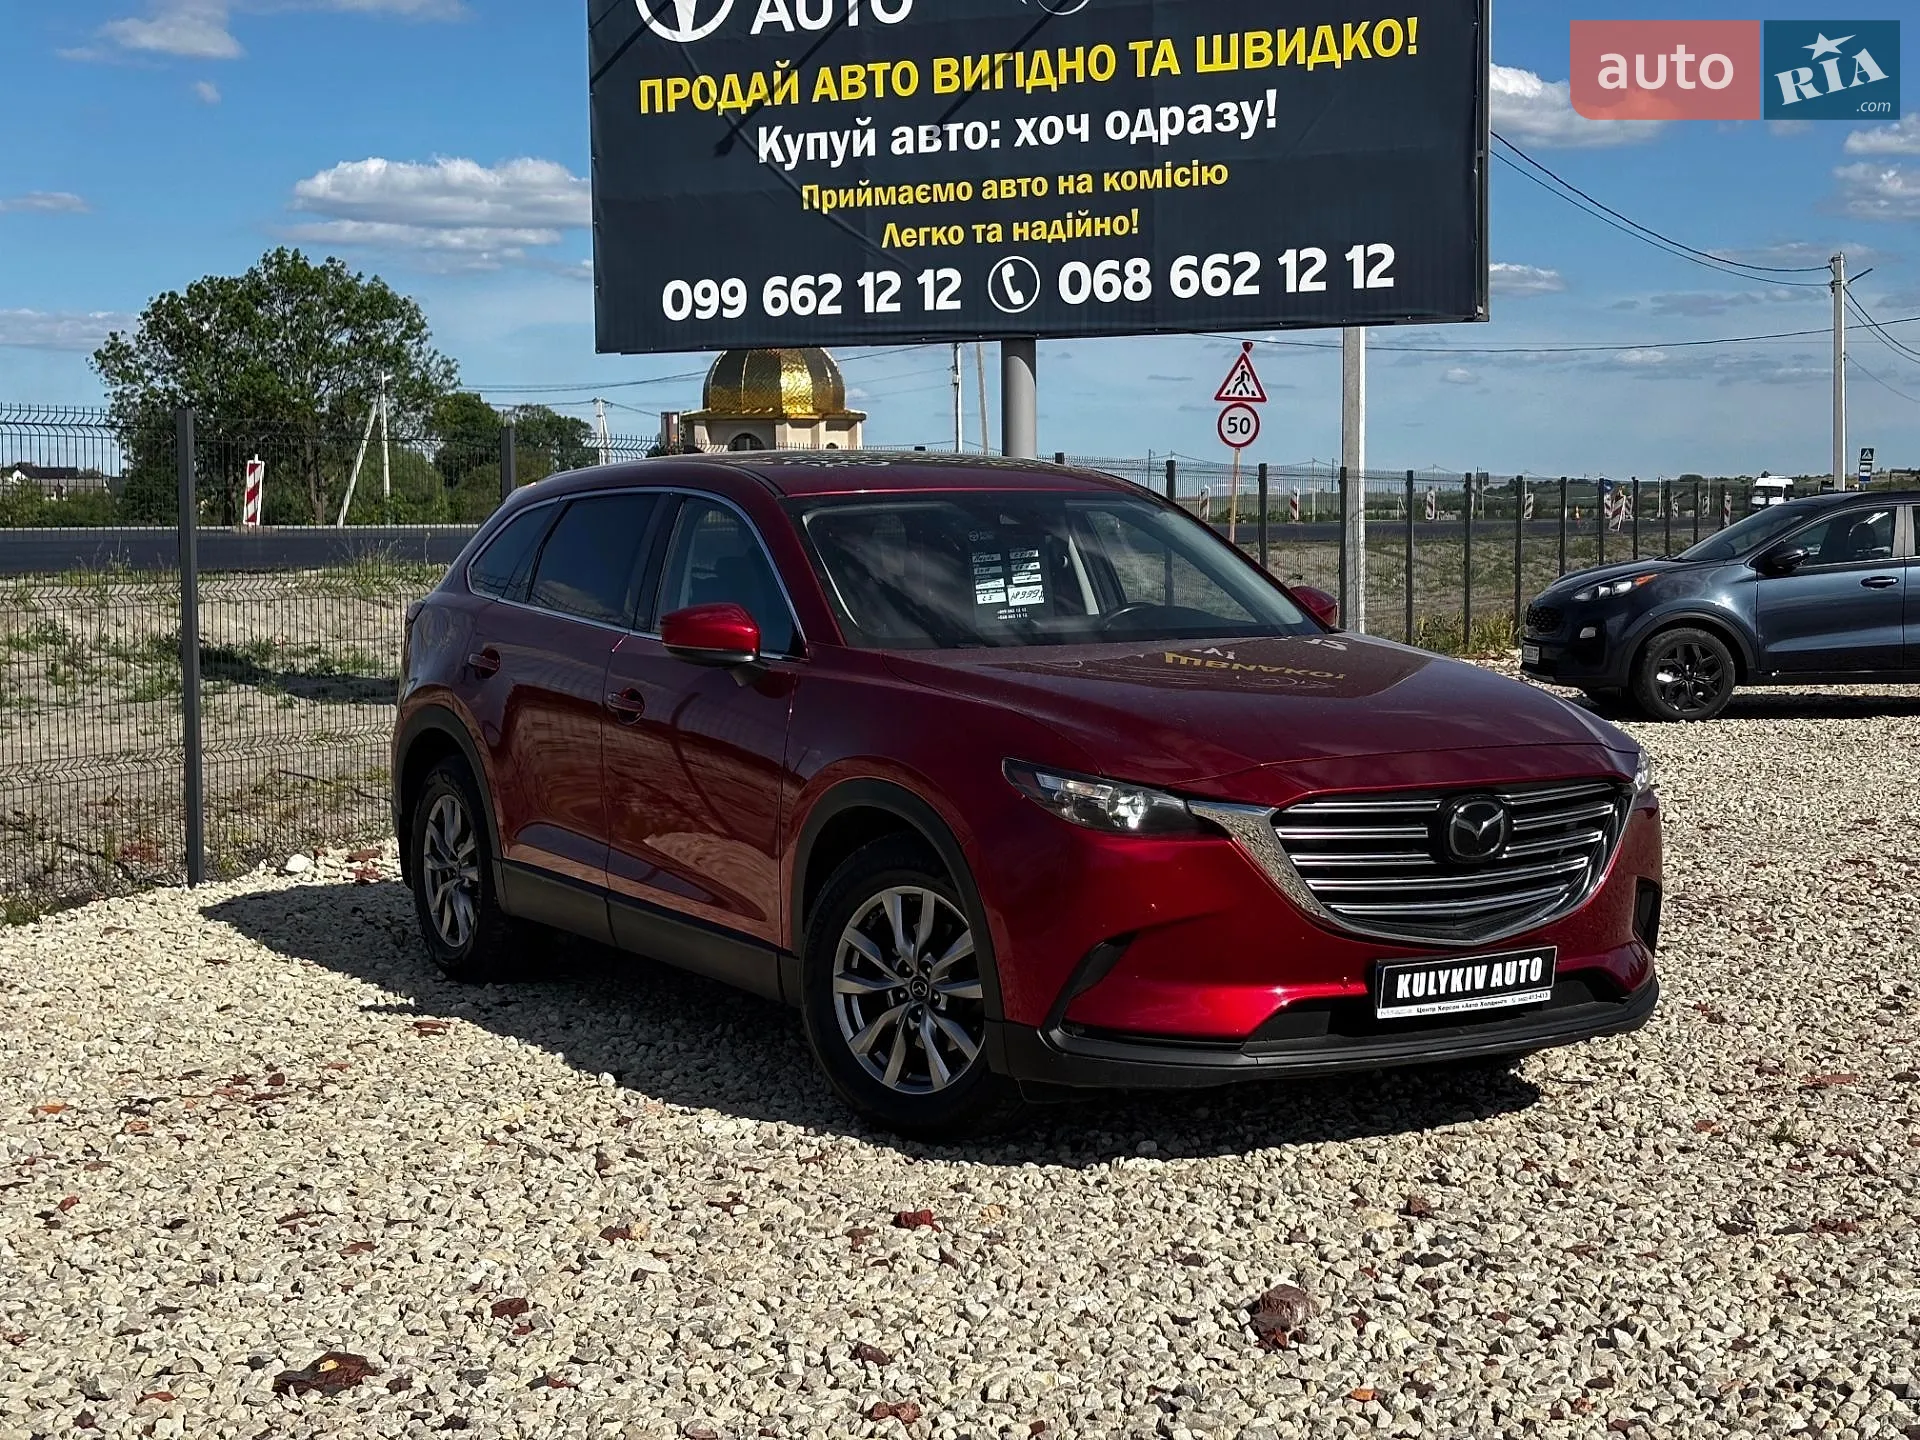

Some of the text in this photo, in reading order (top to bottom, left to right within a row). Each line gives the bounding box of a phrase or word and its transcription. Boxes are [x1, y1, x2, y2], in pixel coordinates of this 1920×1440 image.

[639, 17, 1418, 115] ПРОДАЙ АВТО ВИГІДНО ТА ШВИДКО!
[758, 89, 1277, 170] Купуй авто: хоч одразу!
[802, 159, 1229, 215] Приймаємо авто на комісію
[882, 208, 1139, 249] Легко та надійно!
[662, 267, 962, 321] 099 662 12 12
[1058, 243, 1395, 305] 068 662 12 12
[1227, 417, 1251, 434] 50
[1396, 956, 1543, 999] KULYKIV AUTO
